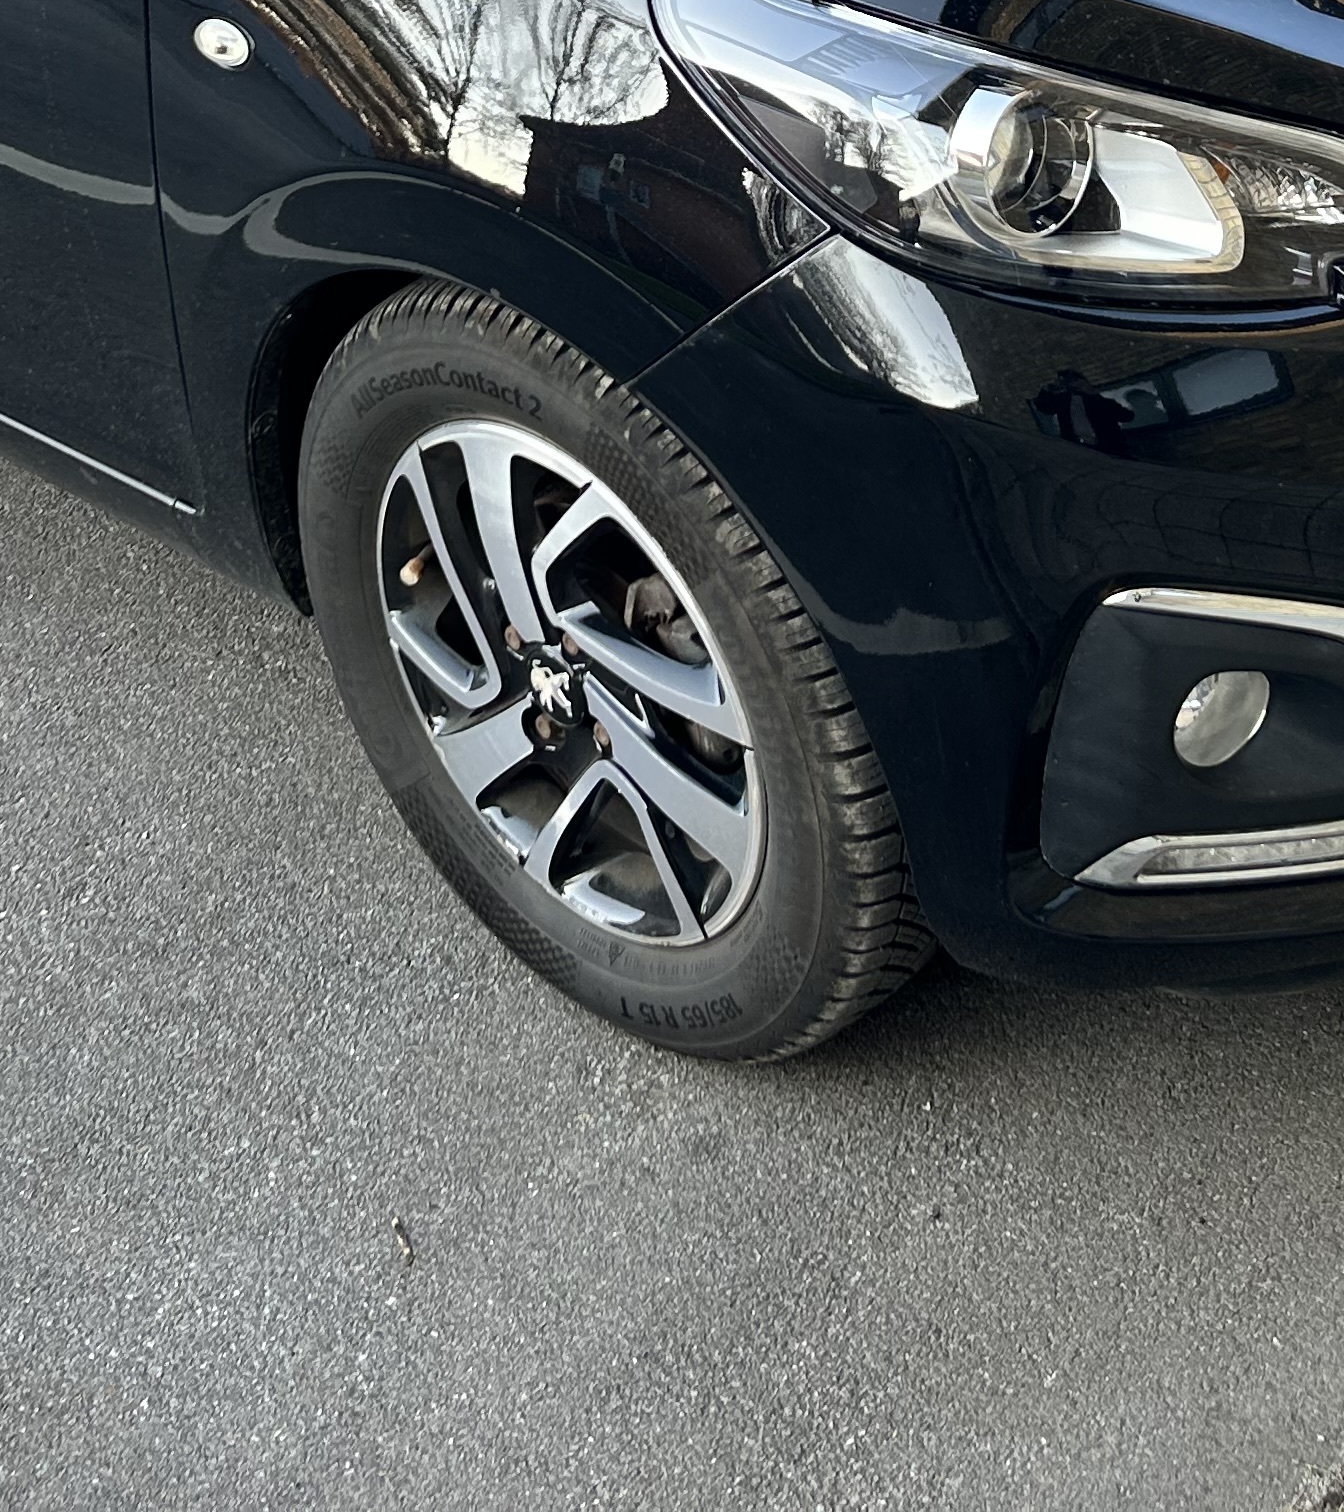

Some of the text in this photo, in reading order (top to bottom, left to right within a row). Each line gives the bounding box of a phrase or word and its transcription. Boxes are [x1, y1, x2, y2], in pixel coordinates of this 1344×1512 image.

[349, 361, 544, 422] AllSeasonContact 2
[680, 992, 744, 1029] 185/65
